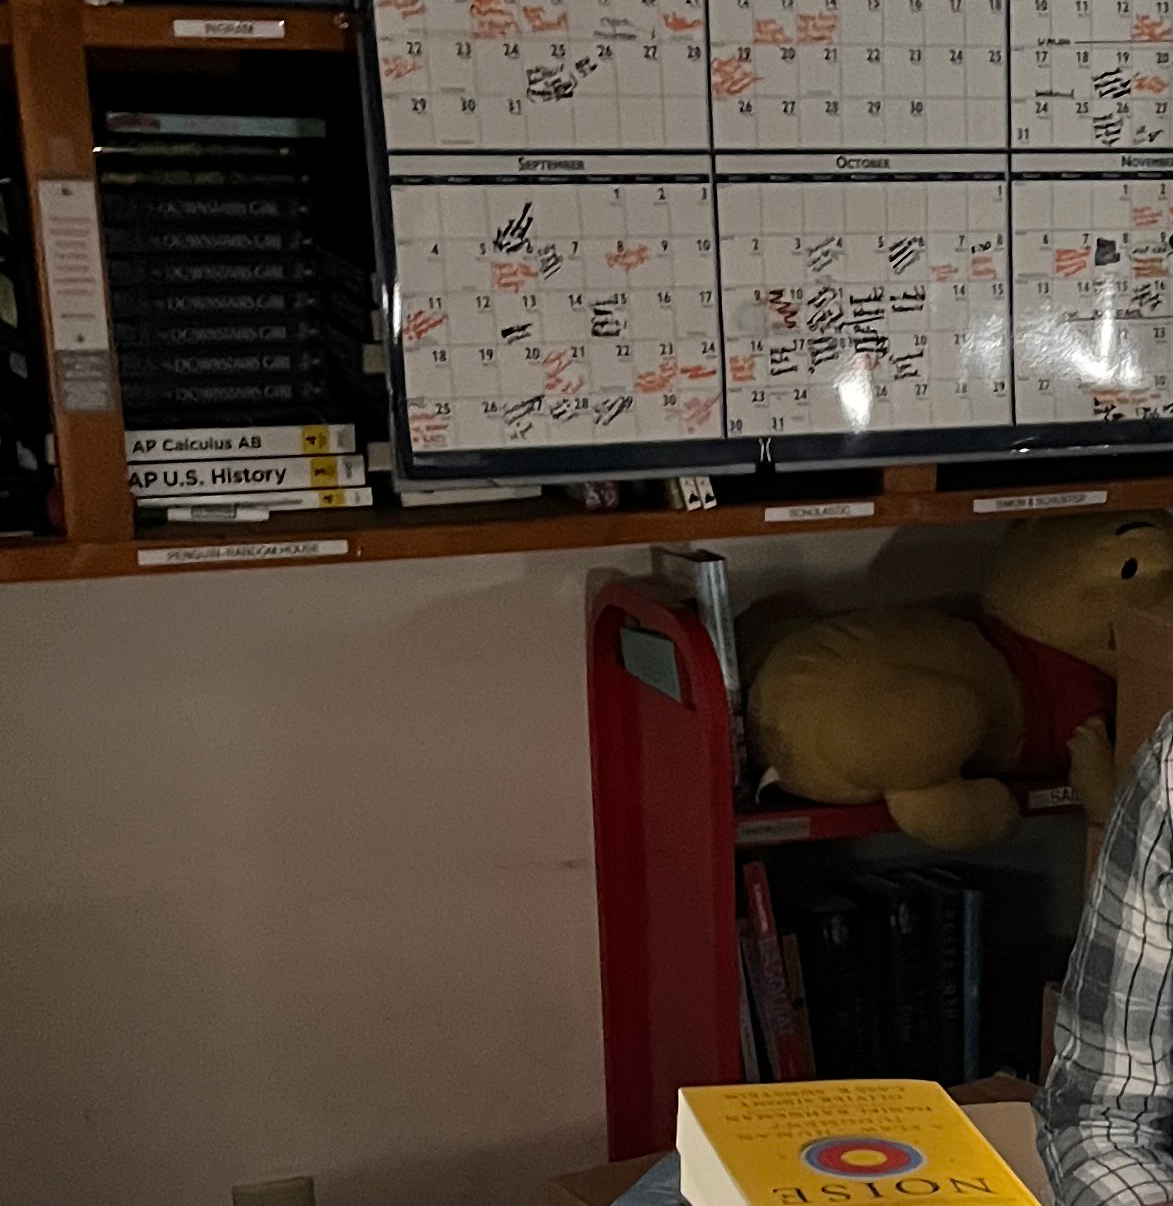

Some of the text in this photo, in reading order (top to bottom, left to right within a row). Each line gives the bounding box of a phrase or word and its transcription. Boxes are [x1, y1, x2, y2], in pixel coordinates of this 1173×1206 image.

[406, 42, 658, 58] 22 23 24 25 27
[780, 48, 1002, 63] 20 22 25
[1035, 52, 1048, 63] 17
[1076, 52, 1090, 63] 18
[1116, 52, 1130, 63] 19
[410, 98, 476, 112] 29 30
[738, 100, 882, 113] 26 28 29
[1034, 102, 1090, 114] 24 25
[835, 155, 891, 169] October
[430, 239, 712, 256] 4 7 9 10
[953, 284, 1005, 296] 14 15
[1076, 282, 1090, 292] 14
[1116, 281, 1129, 292] 15
[428, 290, 713, 310] 11 12 13 14 16 17
[1152, 327, 1166, 338] 23
[432, 344, 631, 362] 18 19 20 22
[750, 340, 764, 352] 16
[751, 388, 808, 402] 23 24
[434, 402, 498, 416] 25 26
[133, 436, 262, 453] AP Calculus AB
[129, 468, 287, 489] AP U.S. History
[772, 1177, 998, 1206] NOISE
